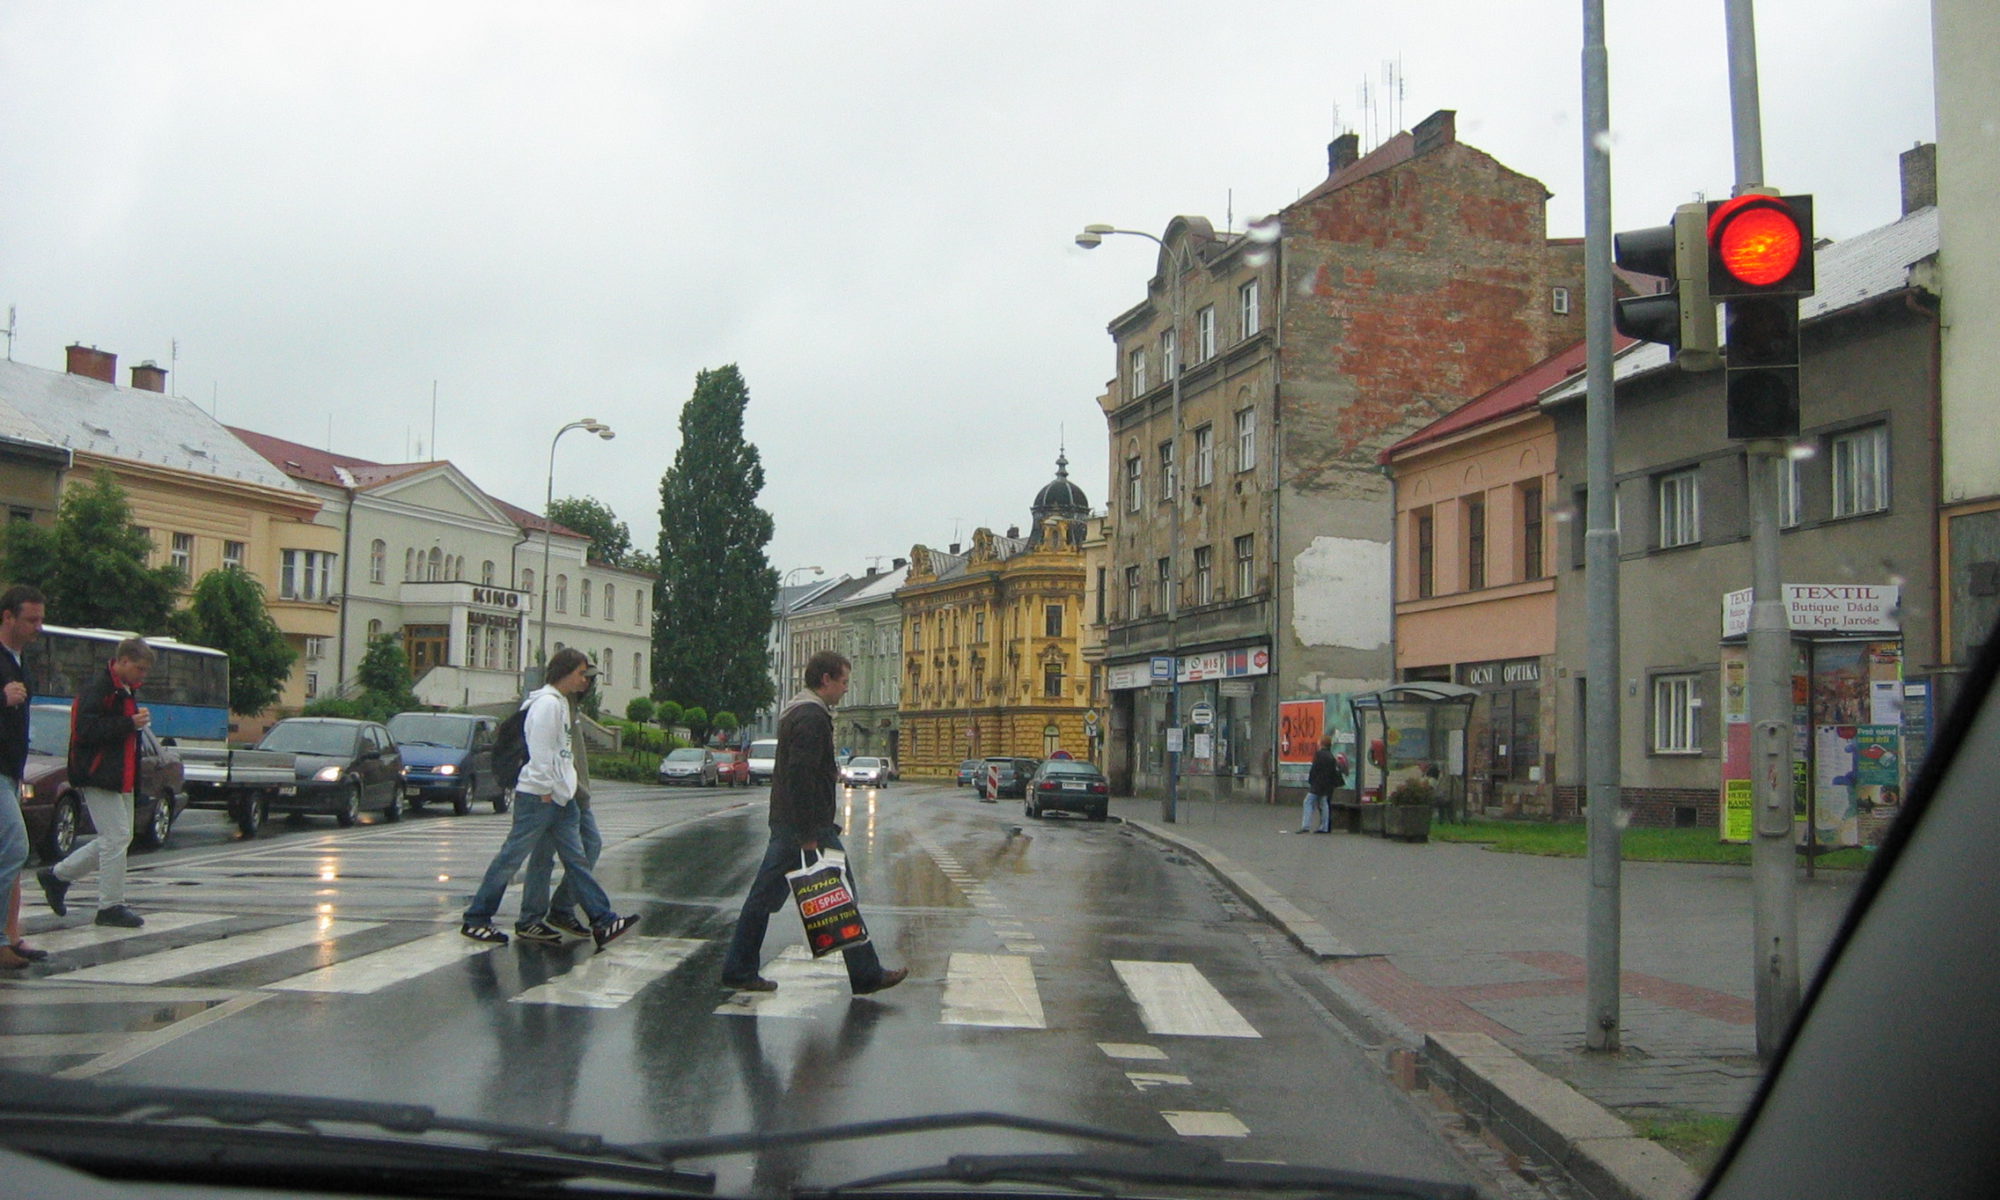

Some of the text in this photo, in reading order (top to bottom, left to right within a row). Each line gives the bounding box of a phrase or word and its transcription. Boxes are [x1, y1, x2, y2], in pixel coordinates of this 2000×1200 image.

[473, 587, 518, 608] KINO
[1790, 587, 1880, 600] TEXTIL
[1792, 602, 1880, 614] Butique Dáda
[1503, 664, 1538, 682] OPTIKA
[798, 877, 840, 895] AUTHO
